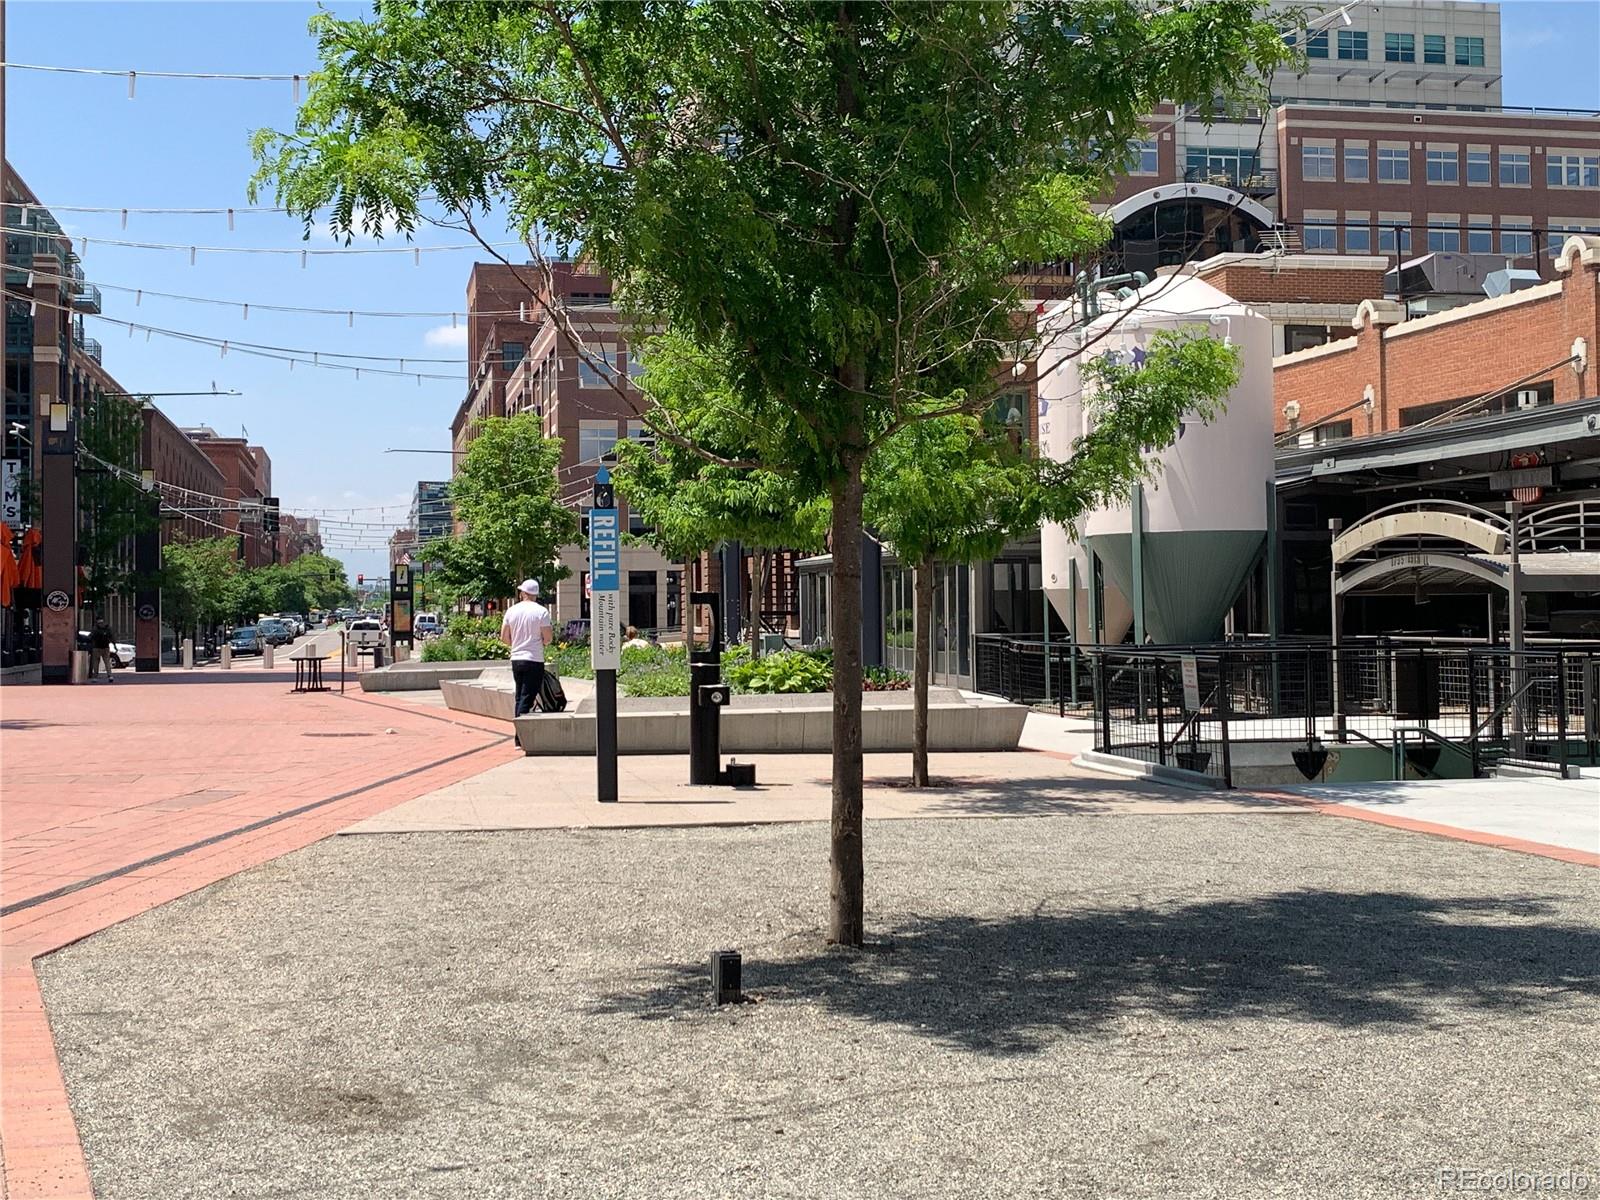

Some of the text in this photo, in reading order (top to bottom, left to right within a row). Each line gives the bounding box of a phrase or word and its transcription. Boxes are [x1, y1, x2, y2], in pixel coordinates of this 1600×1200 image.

[594, 516, 616, 580] REFILL
[598, 593, 606, 656] Mountain water
[606, 593, 616, 653] with pure Rocky
